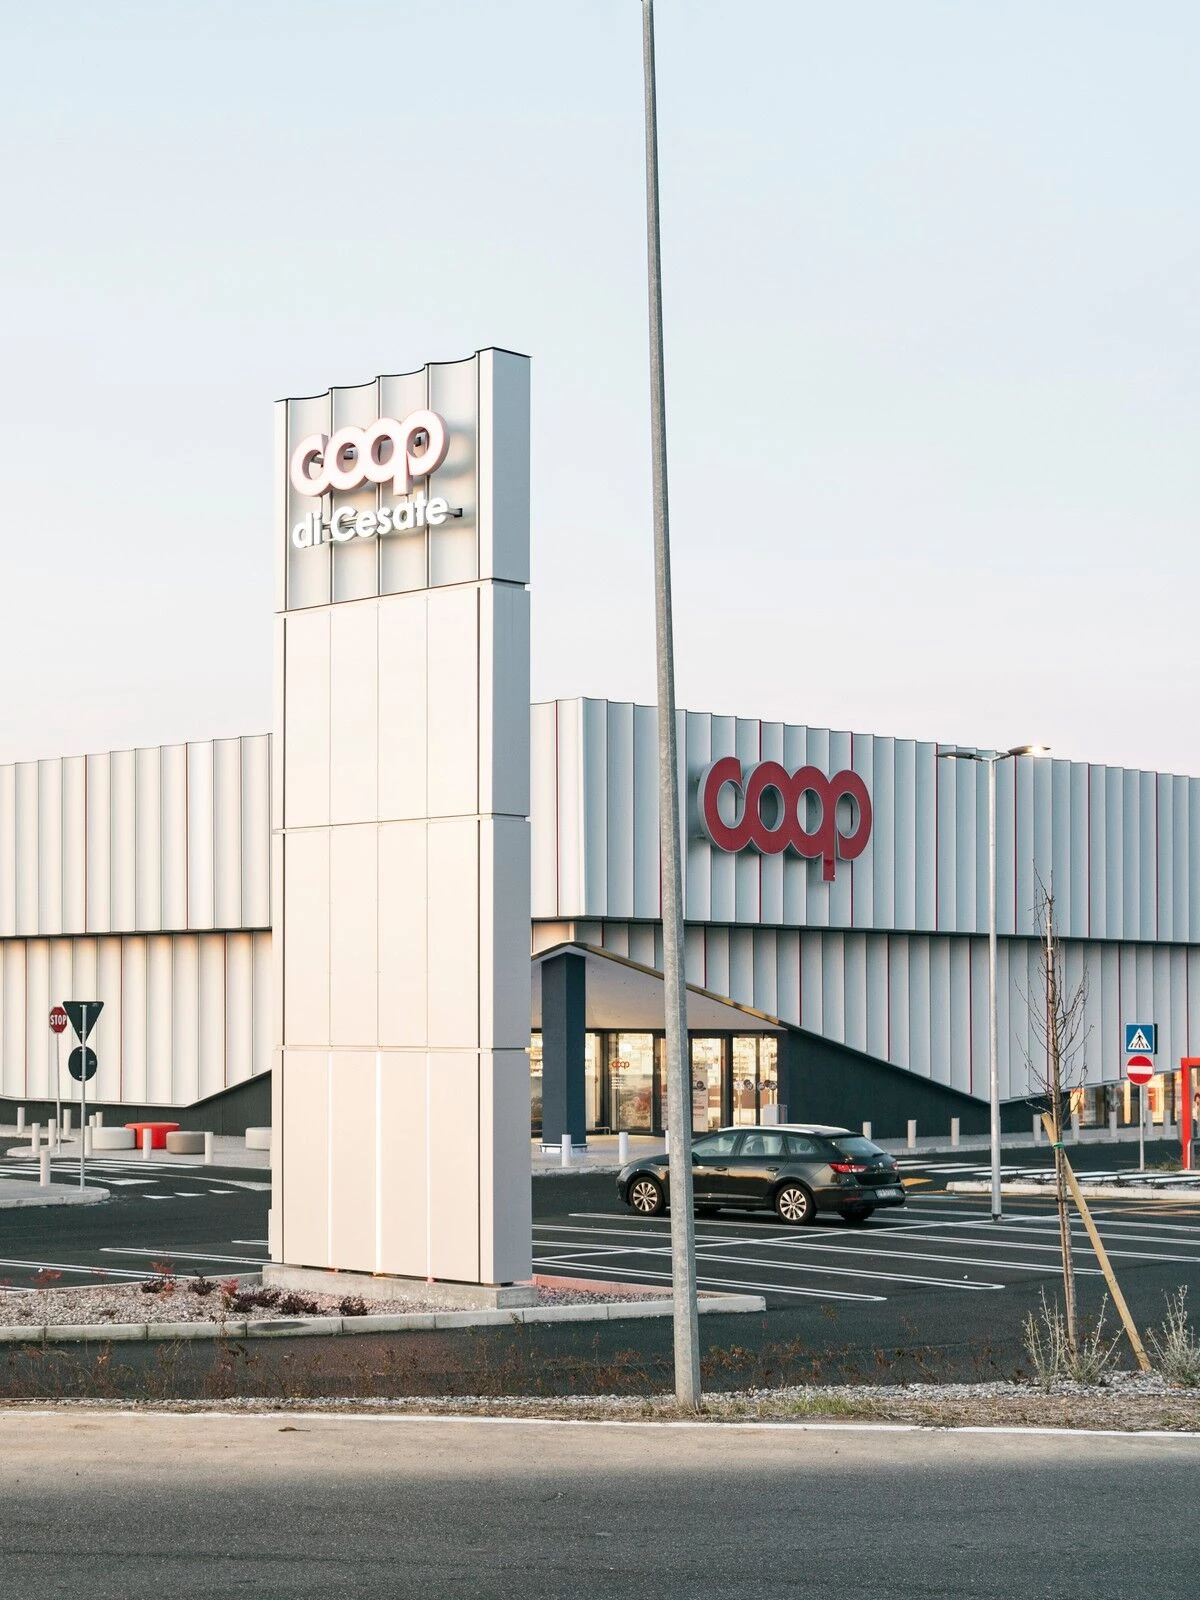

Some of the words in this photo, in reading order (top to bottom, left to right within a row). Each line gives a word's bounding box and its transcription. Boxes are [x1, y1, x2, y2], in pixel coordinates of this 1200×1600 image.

[290, 408, 450, 497] coop
[292, 510, 324, 549] di
[331, 493, 450, 543] Cesate
[700, 756, 873, 882] coop
[50, 1014, 67, 1025] STOP
